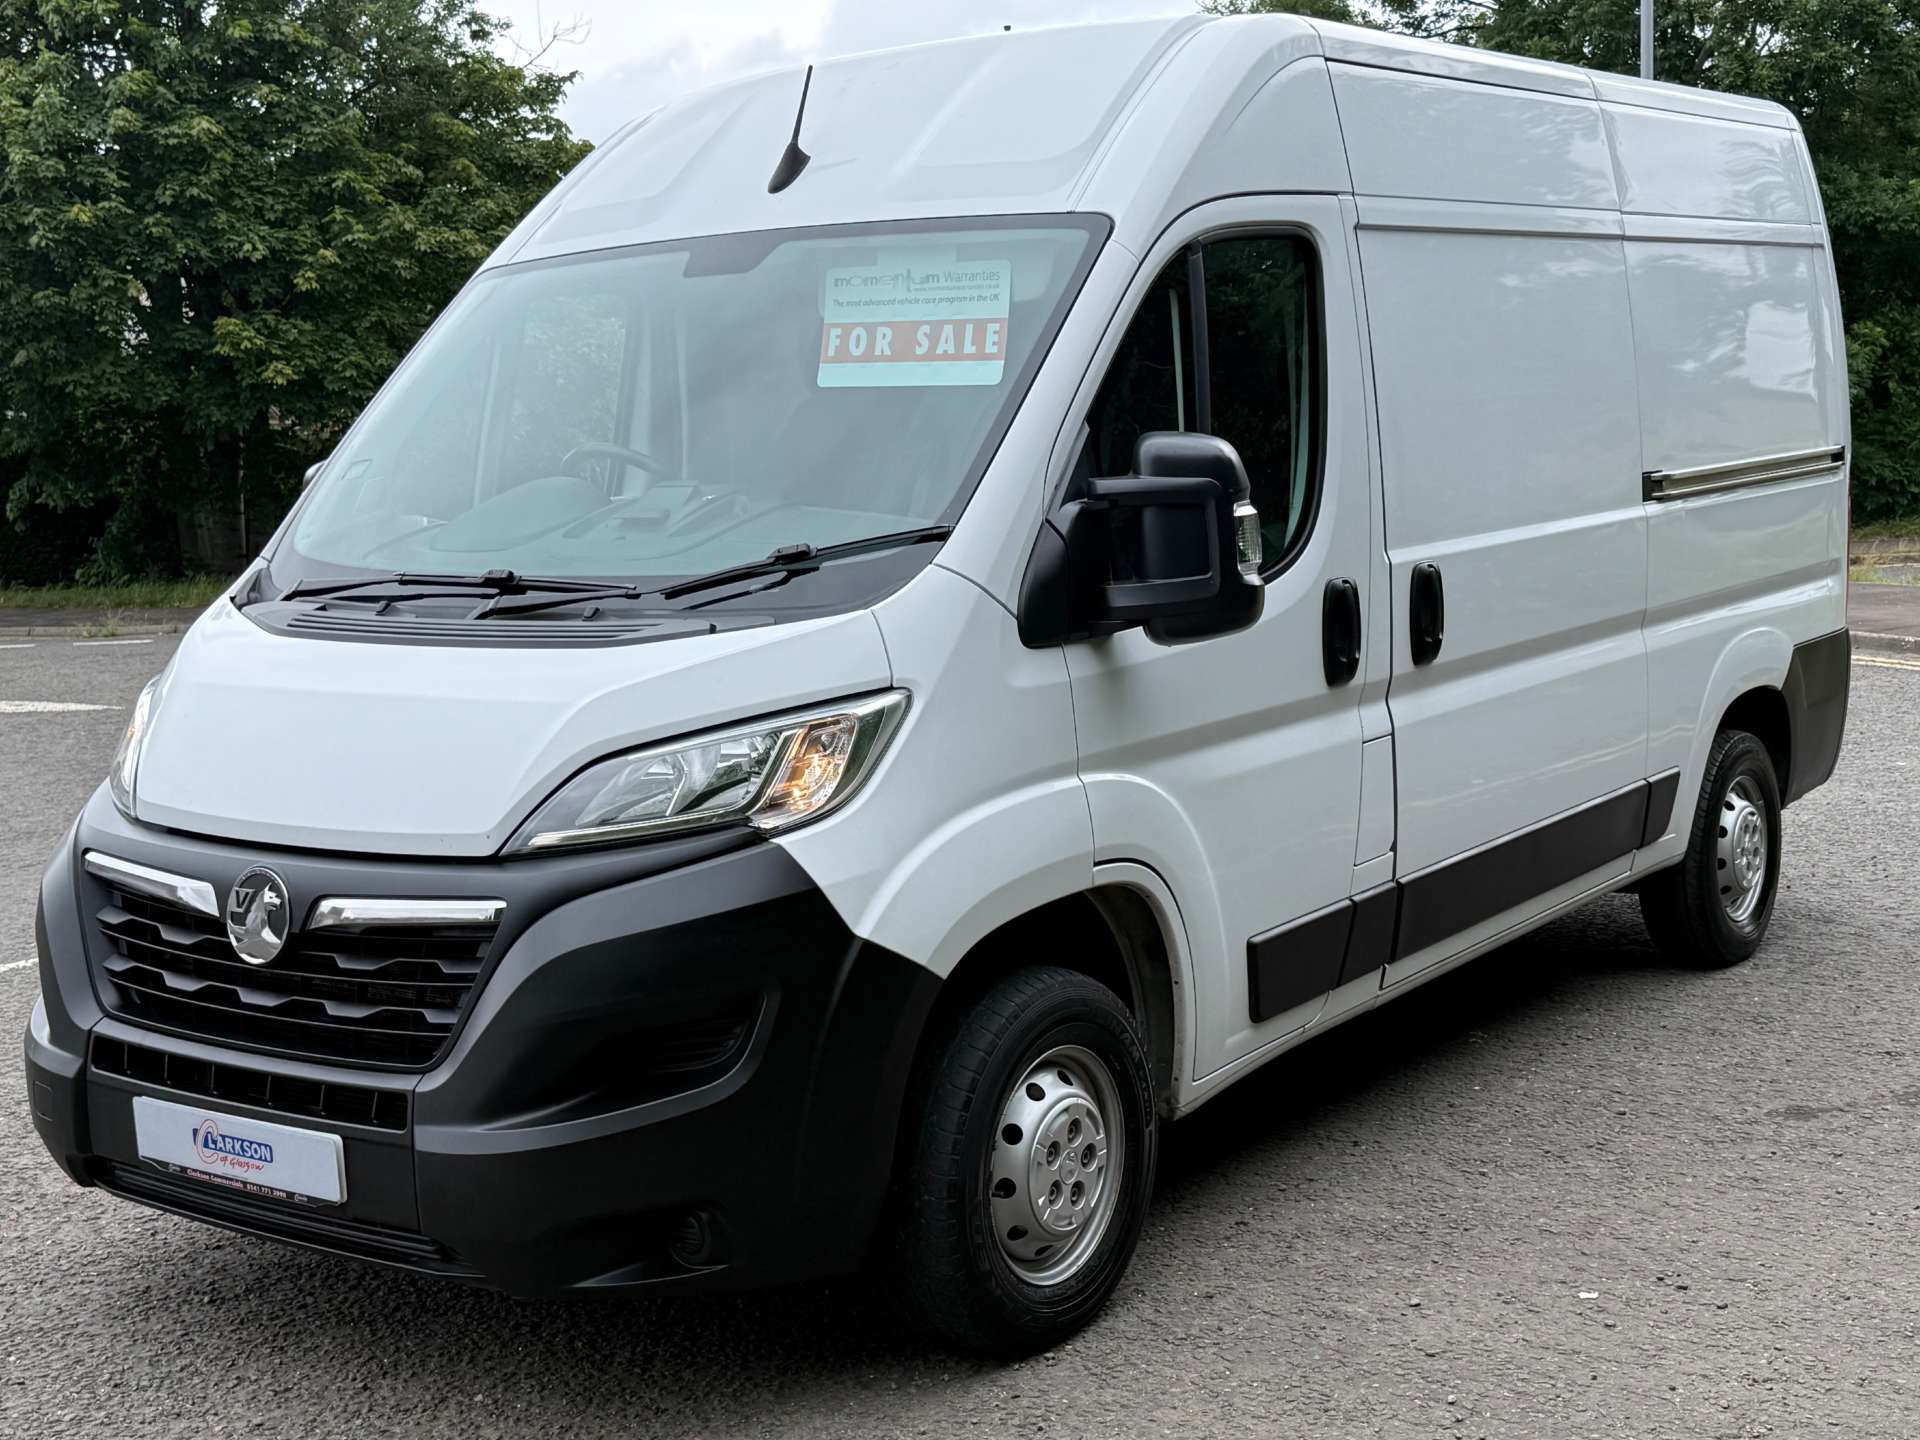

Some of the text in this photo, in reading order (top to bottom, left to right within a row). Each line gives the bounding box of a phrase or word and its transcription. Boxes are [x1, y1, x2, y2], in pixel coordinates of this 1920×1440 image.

[943, 270, 1001, 284] Warranties
[833, 298, 845, 307] The
[846, 298, 862, 307] most
[862, 297, 896, 307] advanced
[897, 296, 920, 306] vehicle
[937, 295, 968, 306] program
[977, 293, 988, 302] the
[989, 293, 1000, 303] UK
[828, 323, 1001, 357] FOR SALE
[196, 1119, 273, 1164] CLARKSON
[219, 1154, 265, 1173] of Glasgow
